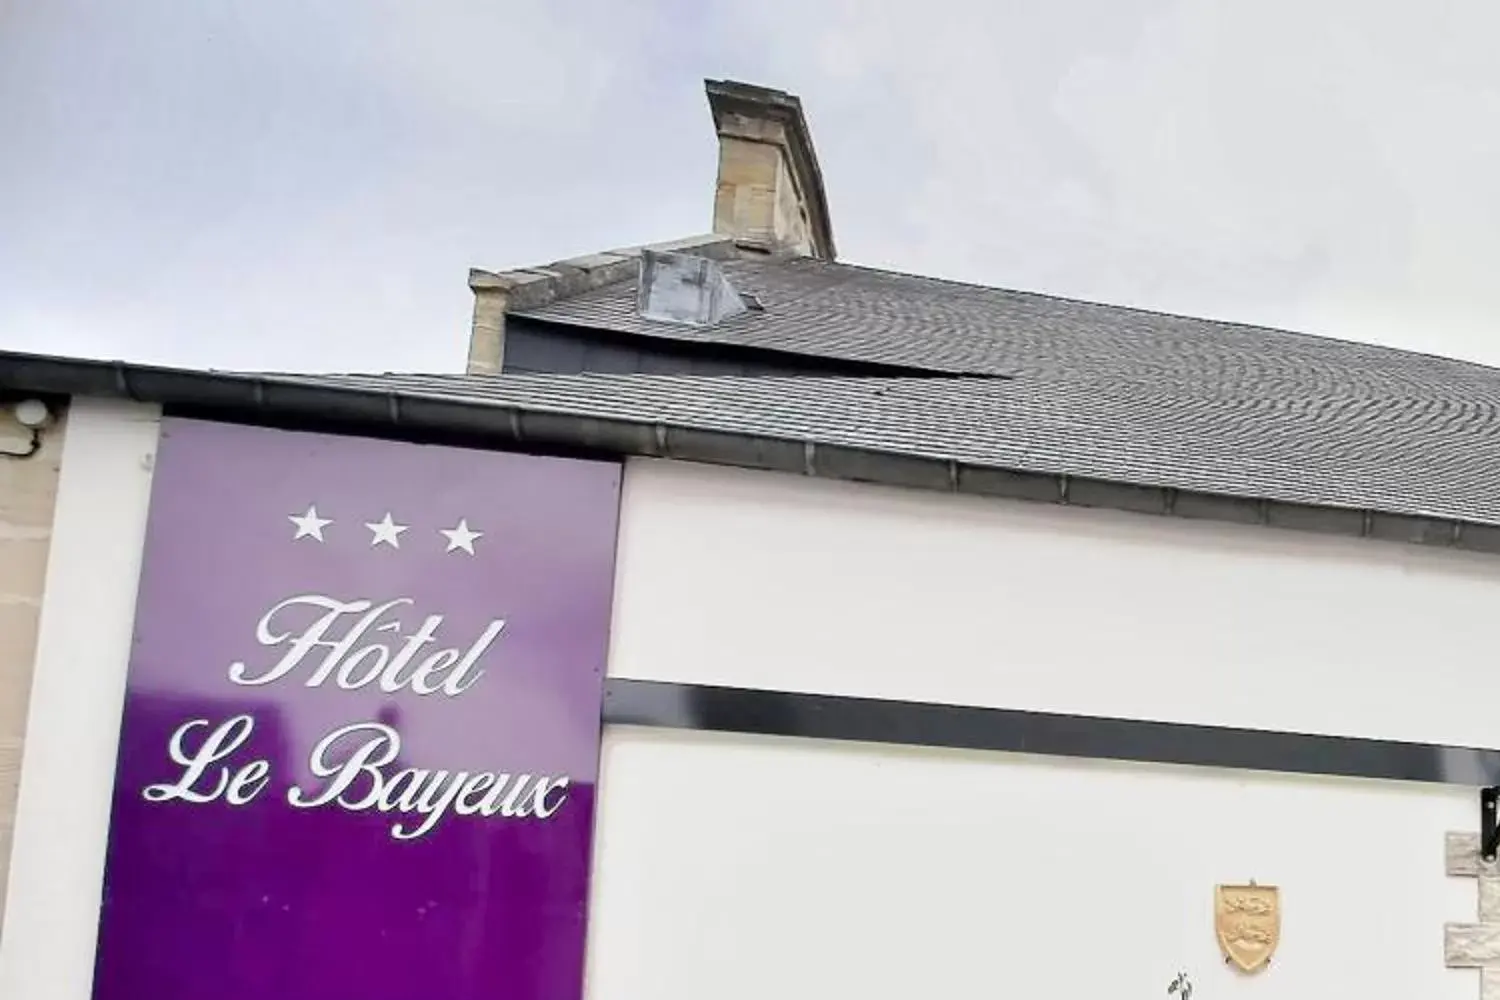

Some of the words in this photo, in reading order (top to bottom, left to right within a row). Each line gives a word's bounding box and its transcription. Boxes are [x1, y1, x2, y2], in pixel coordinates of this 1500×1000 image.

[229, 593, 505, 698] Hôtel
[143, 715, 271, 806] Le
[289, 722, 570, 840] Bayeux
